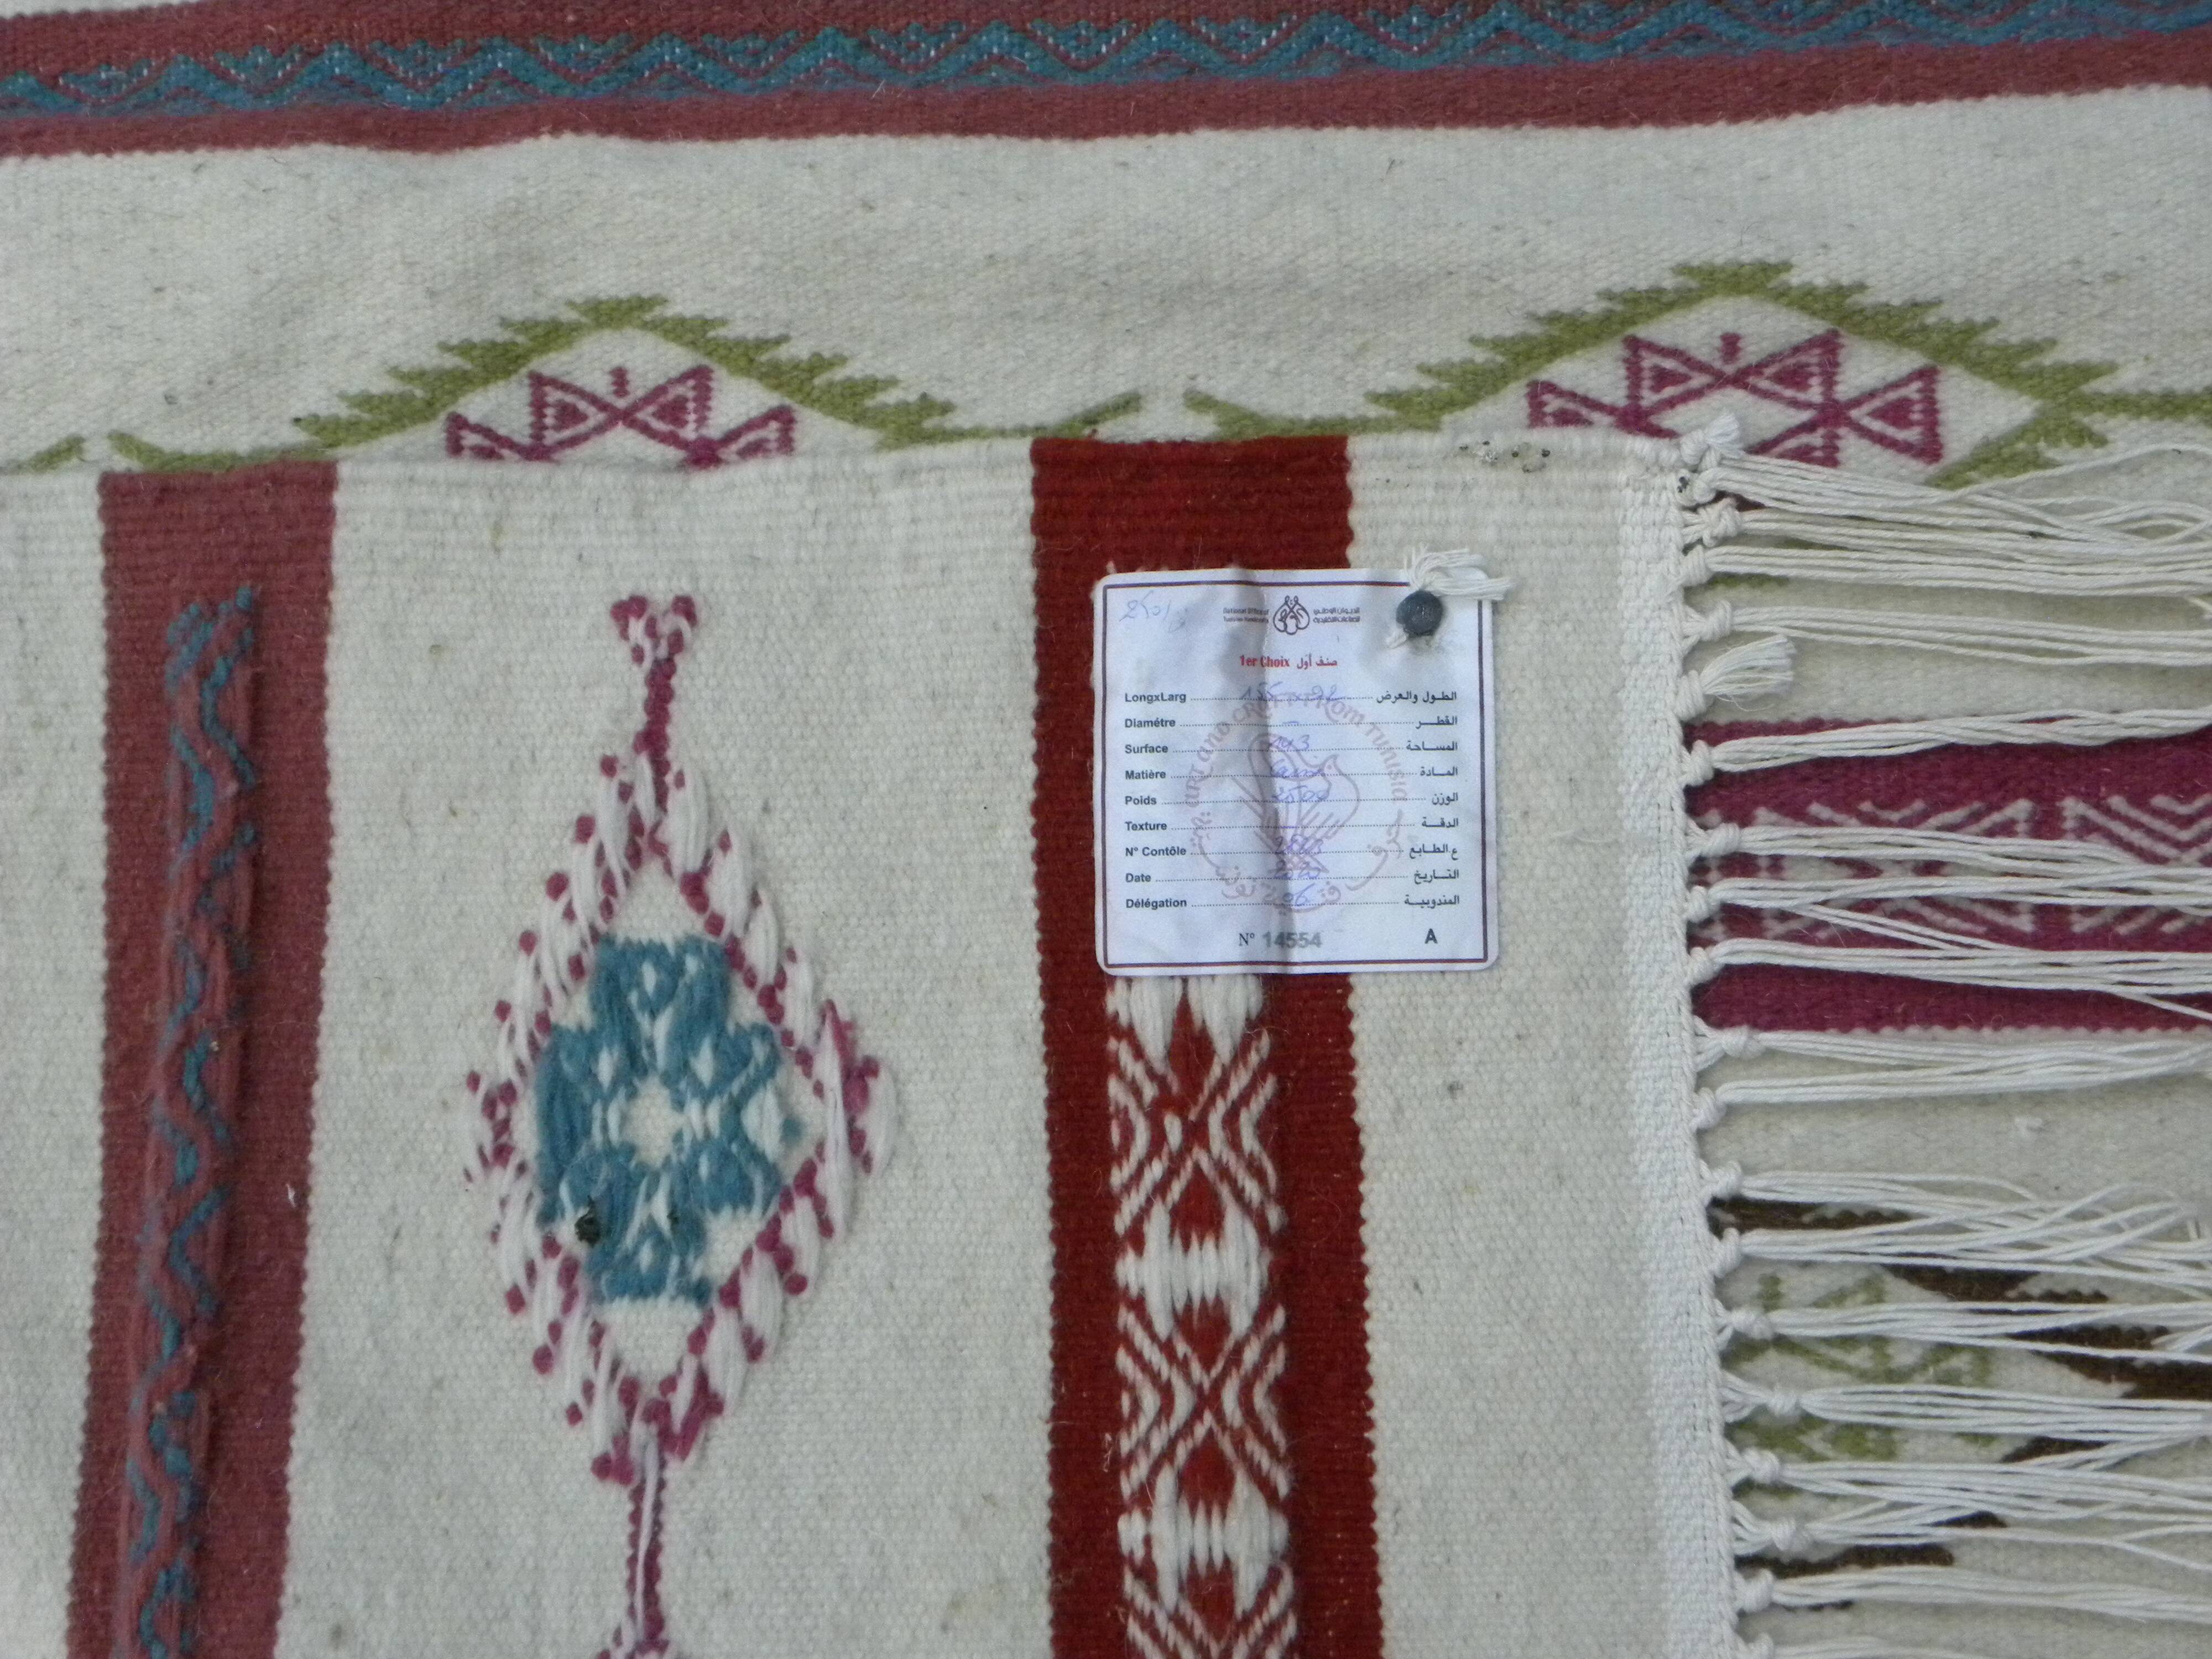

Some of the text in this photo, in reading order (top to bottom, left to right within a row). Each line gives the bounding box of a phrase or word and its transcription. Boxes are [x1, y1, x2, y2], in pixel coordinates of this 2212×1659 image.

[1240, 654, 1290, 667] 1er Choix
[1316, 656, 1338, 667] صنف
[1125, 692, 1187, 704] LongxLarg
[1376, 690, 1418, 704] والعرض
[1124, 718, 1176, 728] Diamétre
[1125, 744, 1169, 754] Surface
[1125, 769, 1167, 780] Matière
[1125, 795, 1157, 805] Poids
[1432, 792, 1459, 806] الوزن
[1125, 821, 1167, 831] Texture
[1125, 846, 1187, 857] N° Contôle
[1125, 873, 1151, 883] Date
[1126, 898, 1187, 910] Délégation
[1238, 931, 1323, 949] N° 14554
[1424, 928, 1438, 944] A
